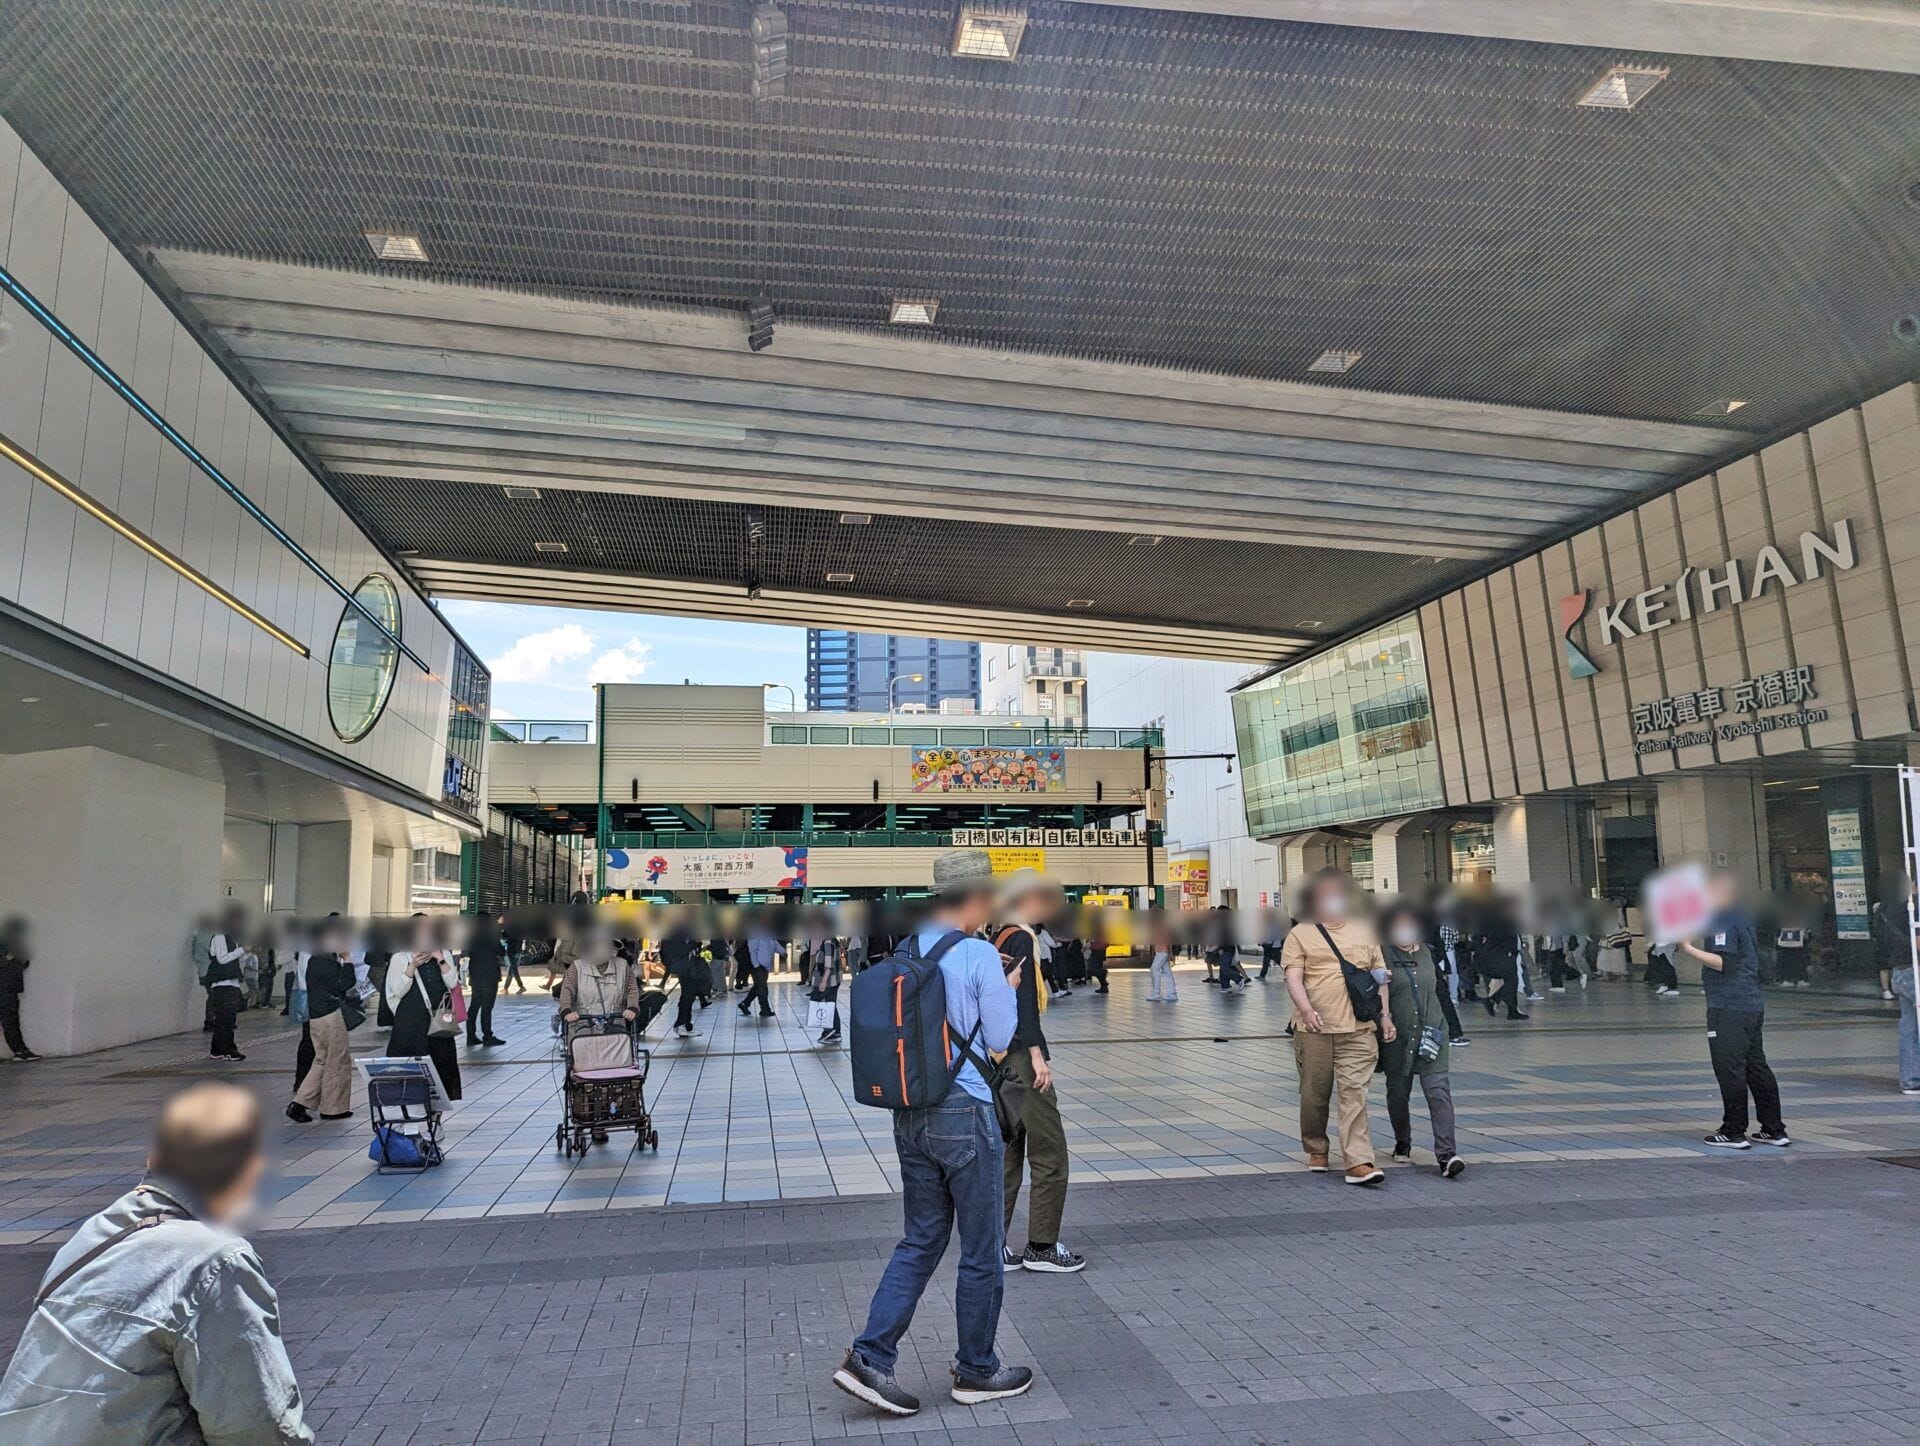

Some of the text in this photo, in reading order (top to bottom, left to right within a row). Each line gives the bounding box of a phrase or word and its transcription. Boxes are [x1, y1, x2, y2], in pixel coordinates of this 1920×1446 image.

[1598, 518, 1856, 646] KEIHAN
[1631, 665, 1815, 734] 京阪電車 京橋駅
[973, 750, 1017, 759] まちづくり
[1632, 707, 1827, 756] Keihan Railway Kyobashi Station
[683, 861, 754, 872] 大阪・関西万博
